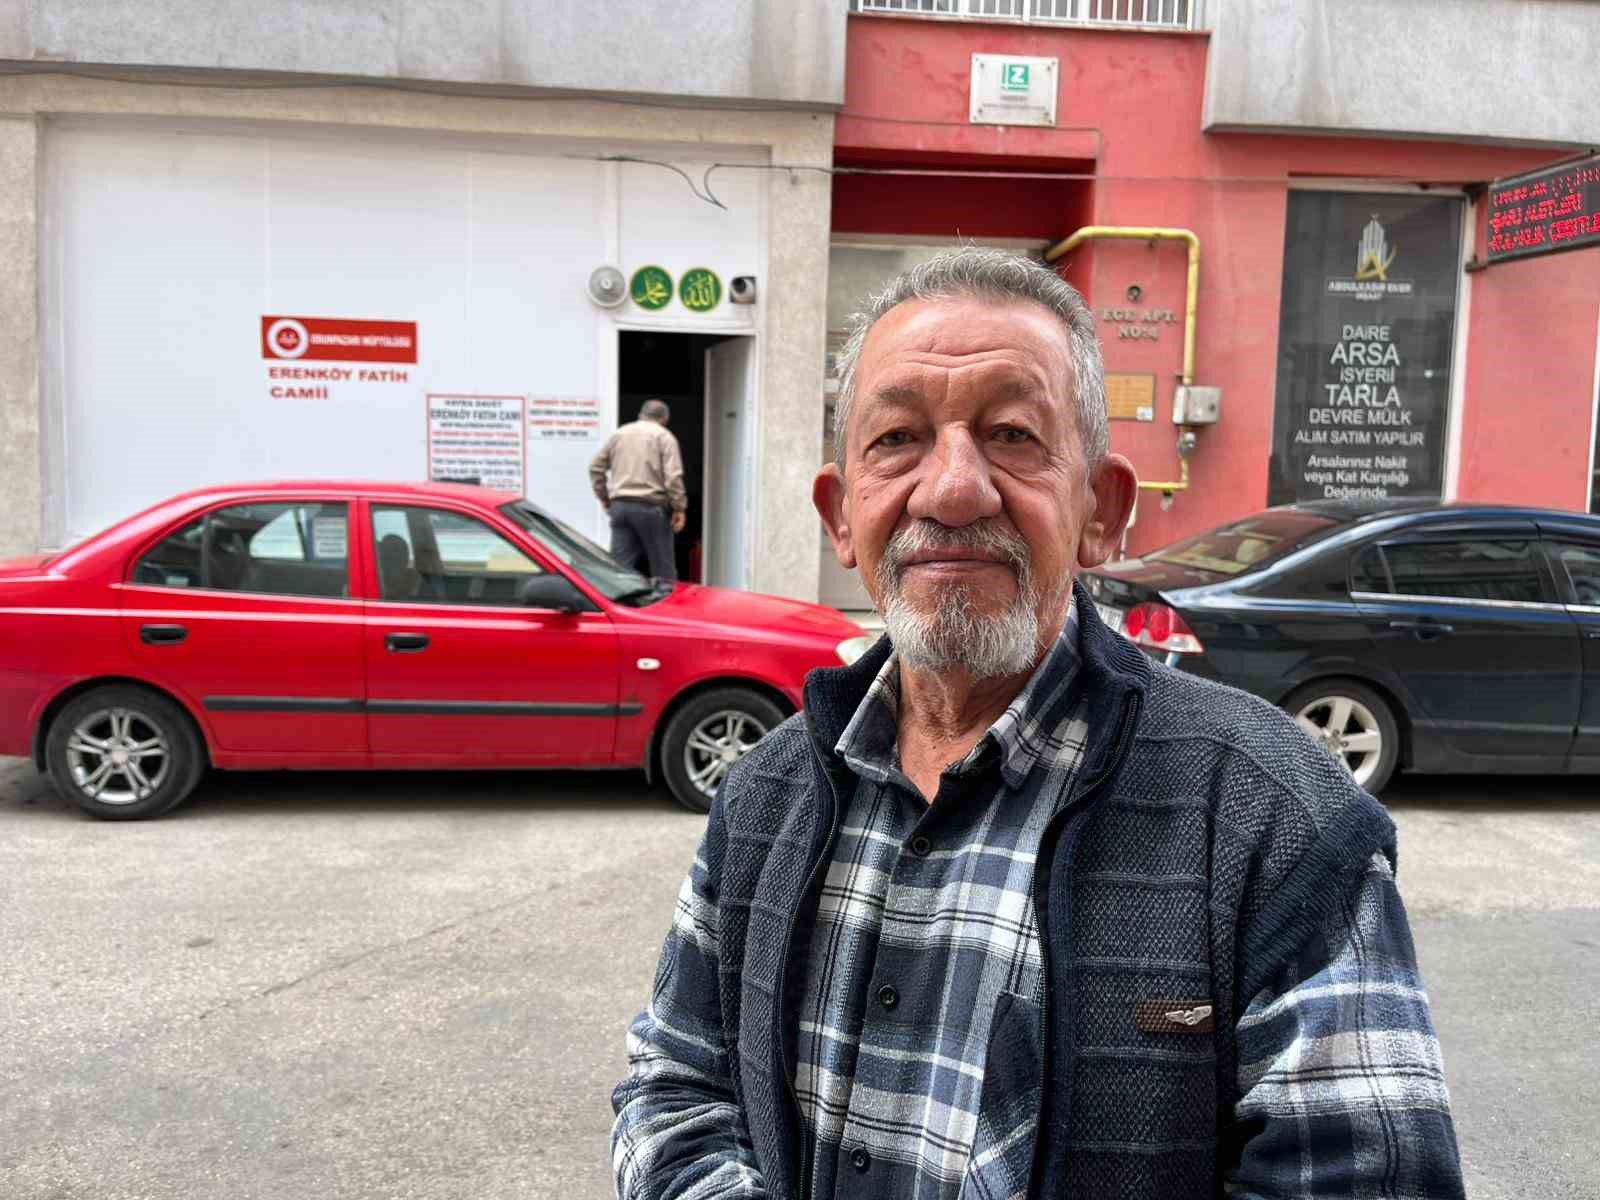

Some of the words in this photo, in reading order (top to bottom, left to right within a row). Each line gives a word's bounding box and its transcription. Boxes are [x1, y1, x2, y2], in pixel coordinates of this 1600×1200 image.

[1330, 341, 1400, 366] ARSA
[269, 366, 352, 380] ERENKÖY
[1325, 383, 1401, 408] TARLA
[1309, 407, 1364, 425] DEVRE
[1367, 407, 1413, 426] MÜLK
[1294, 429, 1328, 444] ALIM
[1330, 430, 1371, 446] SATIM
[1373, 431, 1425, 446] YAPILIR
[1374, 455, 1408, 469] Nakit
[1304, 471, 1333, 486] veya
[1336, 470, 1358, 483] Kat
